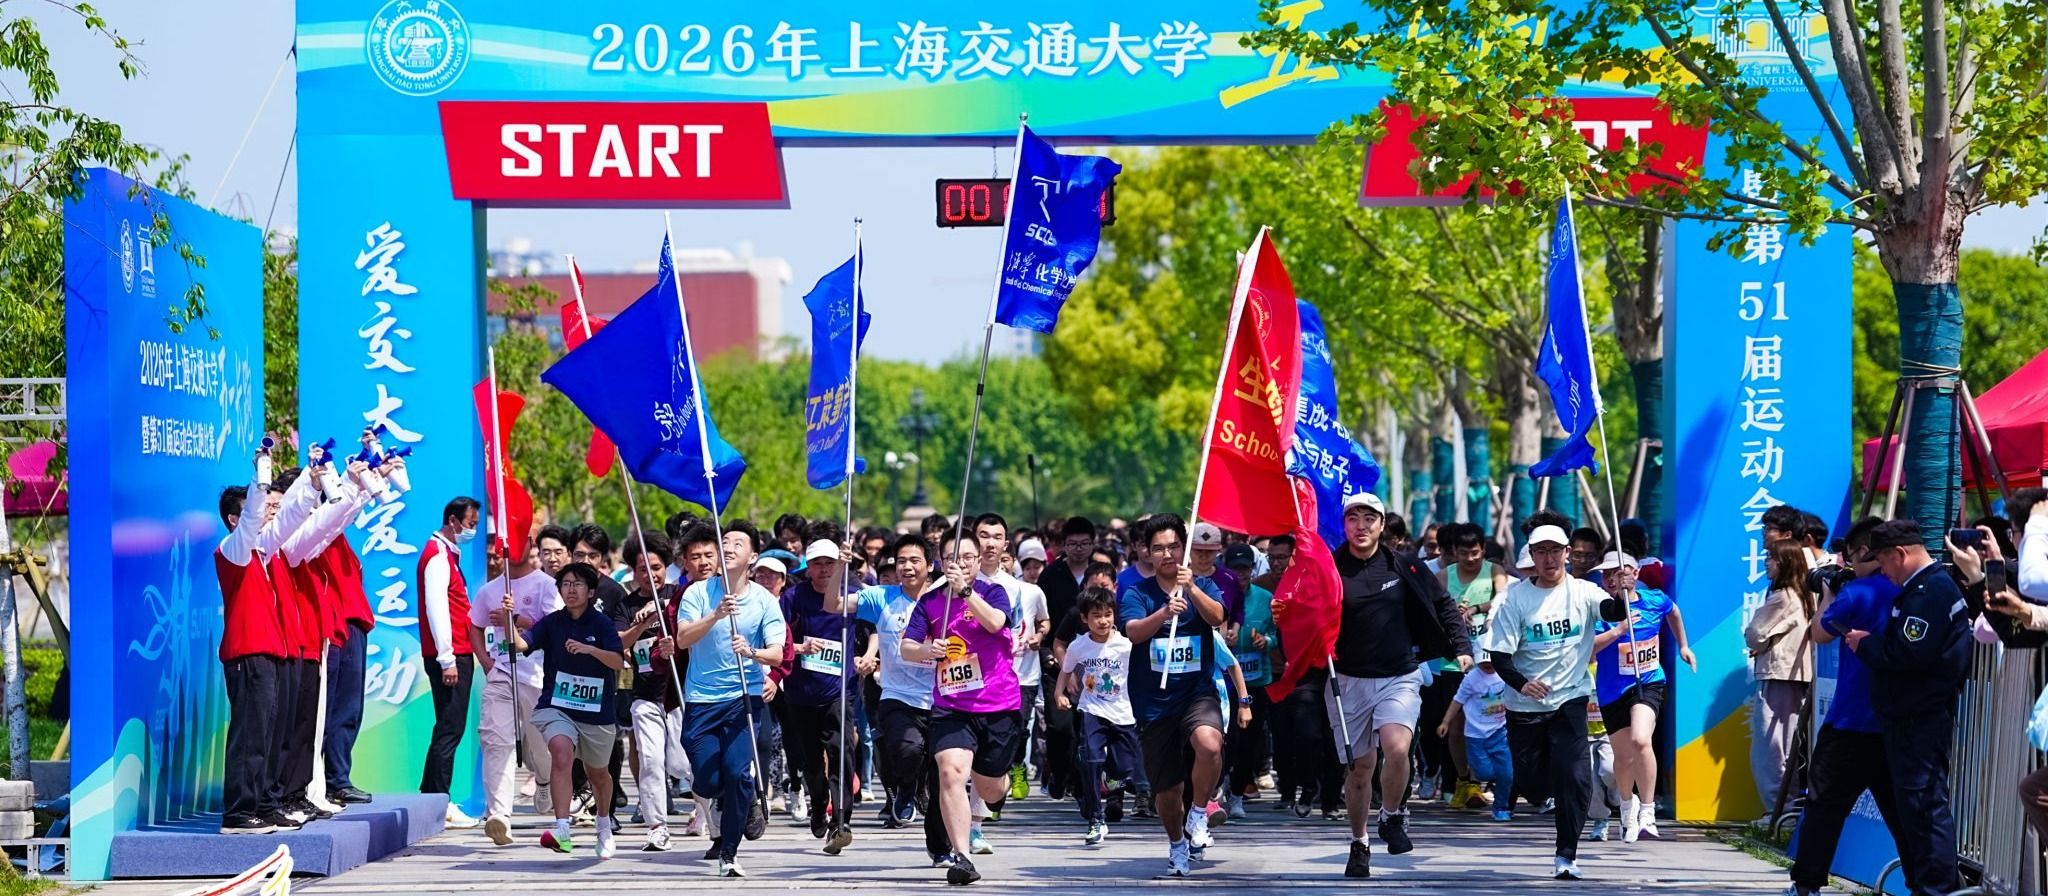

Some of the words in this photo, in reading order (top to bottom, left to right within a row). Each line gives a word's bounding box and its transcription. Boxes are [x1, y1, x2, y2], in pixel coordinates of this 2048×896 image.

[592, 20, 1208, 79] 2026年上海交通大学
[501, 124, 724, 178] START
[140, 339, 219, 400] 2026年上海交通大学
[1533, 623, 1544, 638] A
[1547, 618, 1572, 636] 189
[820, 648, 841, 663] 106
[1171, 646, 1194, 663] 138
[1638, 646, 1657, 664] 065
[941, 669, 948, 684] C
[949, 664, 973, 682] 136
[560, 682, 570, 696] A
[571, 684, 598, 700] 200
